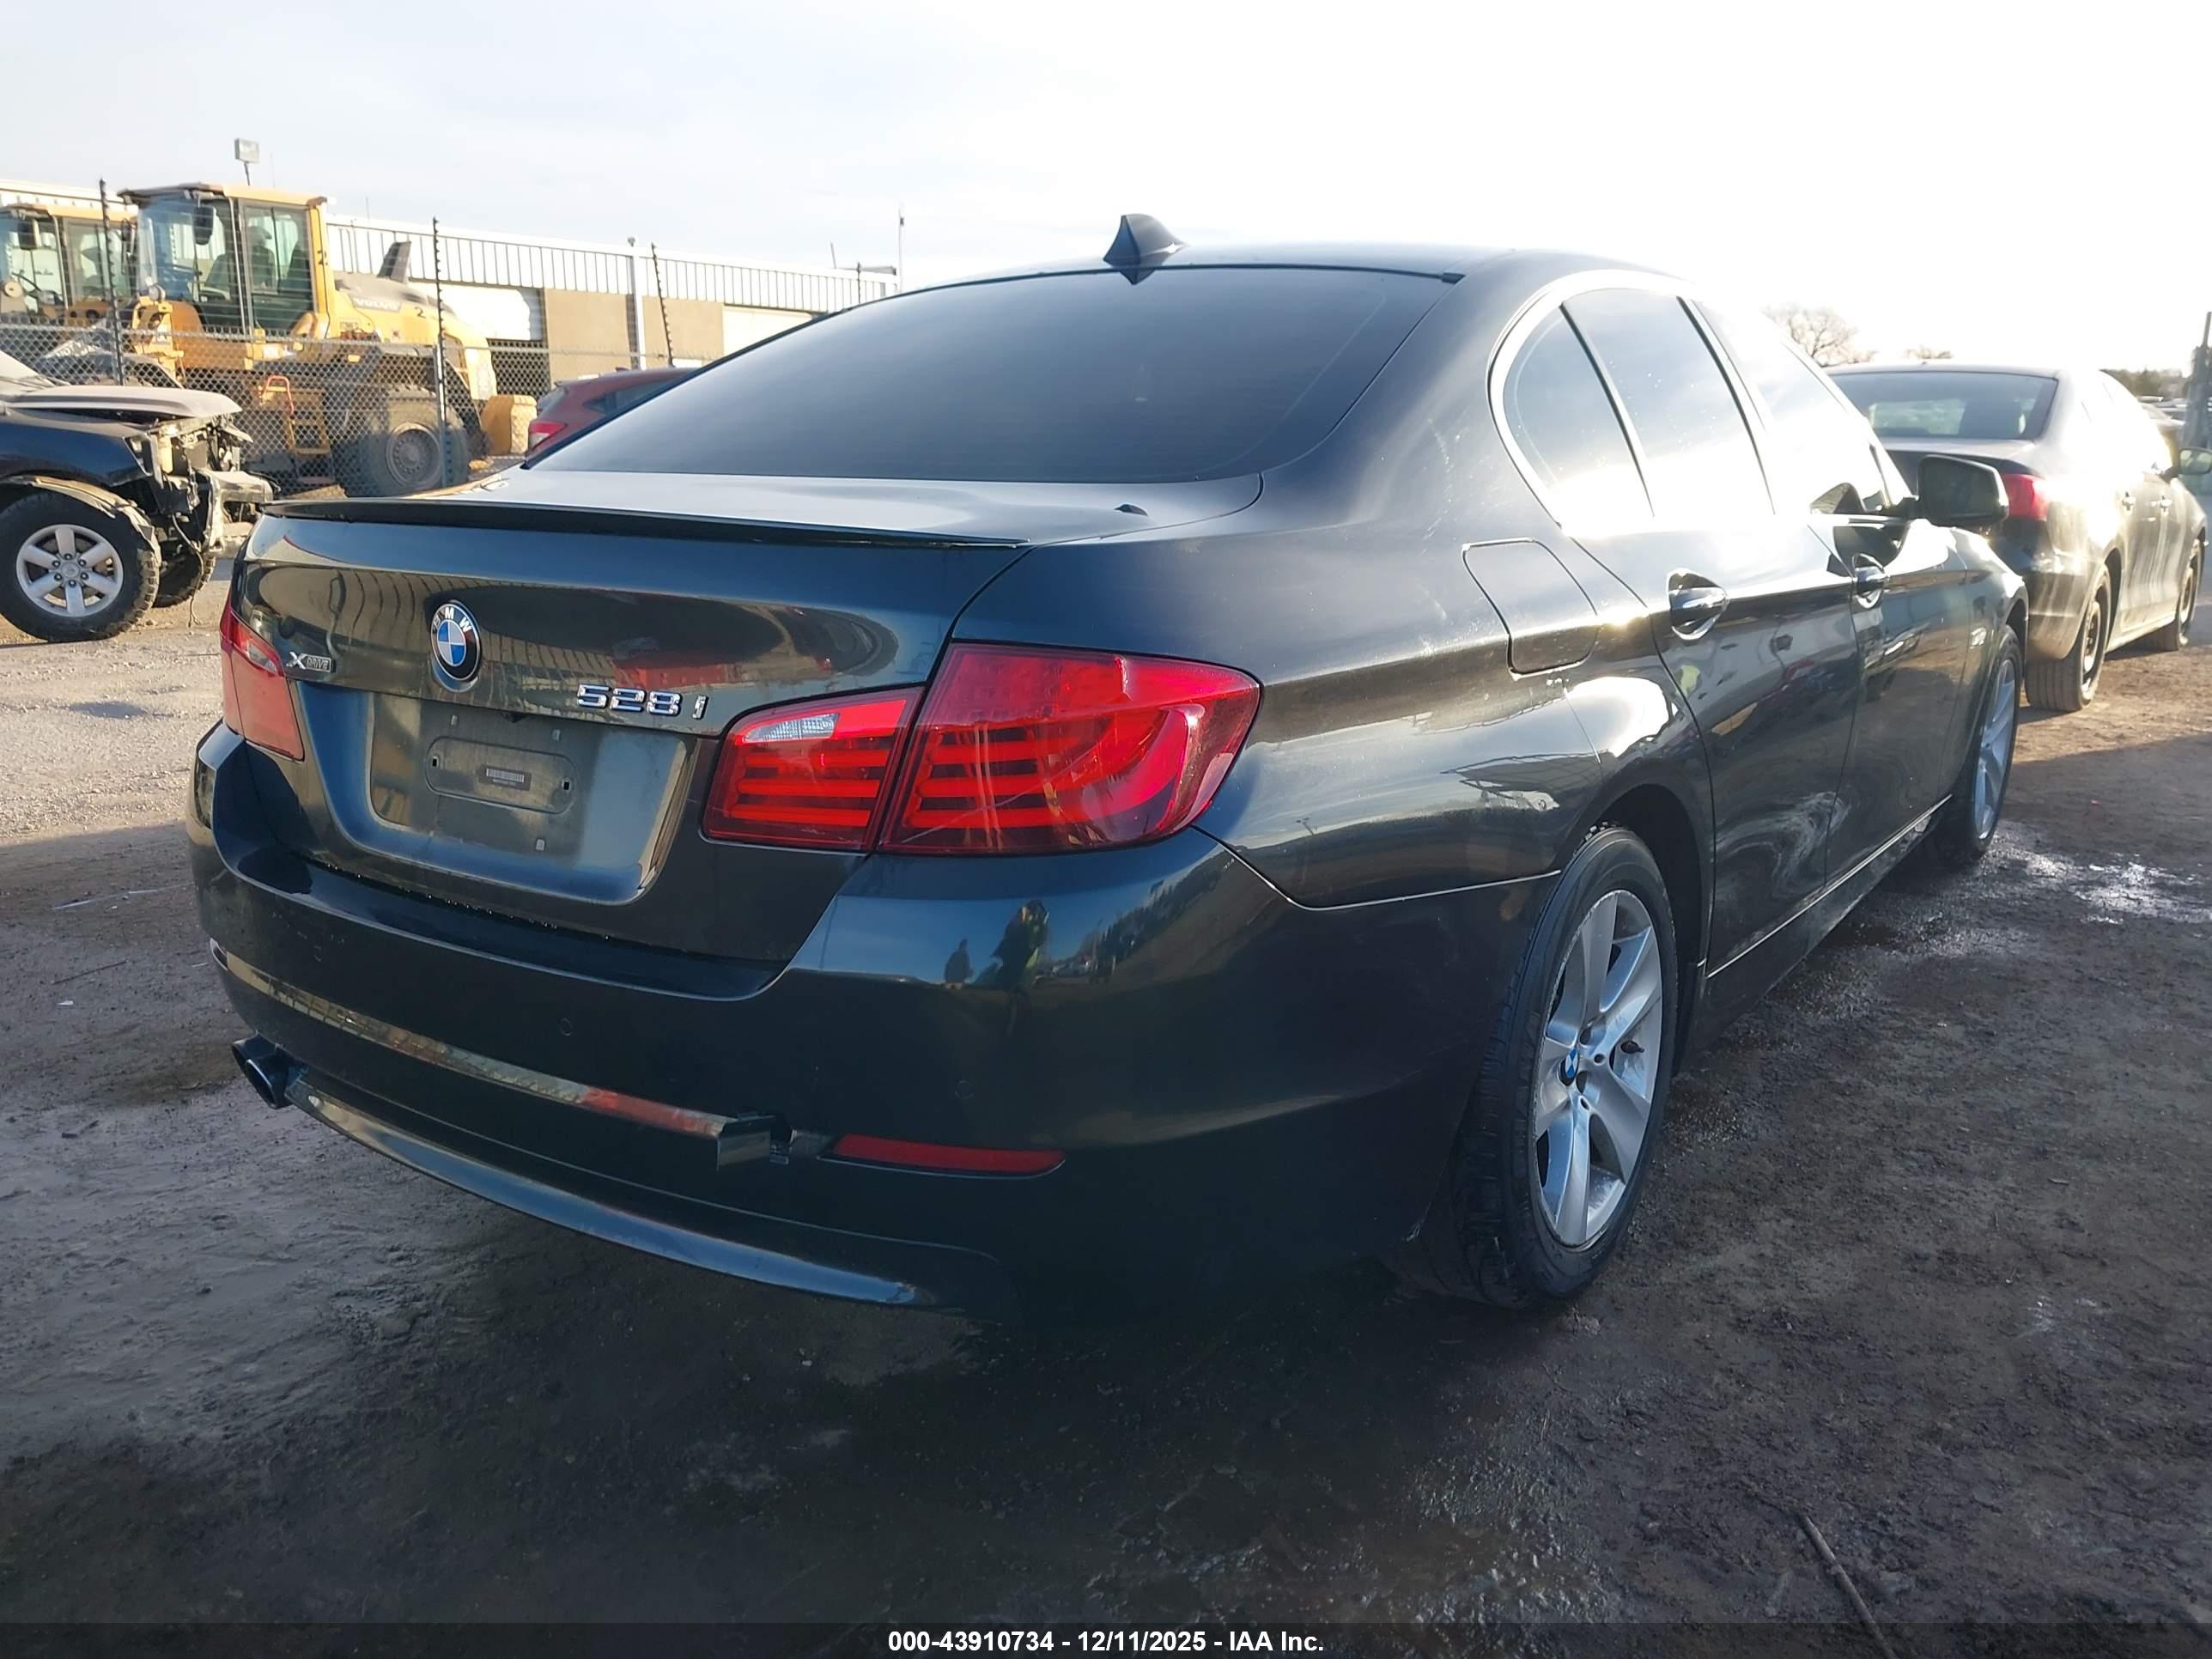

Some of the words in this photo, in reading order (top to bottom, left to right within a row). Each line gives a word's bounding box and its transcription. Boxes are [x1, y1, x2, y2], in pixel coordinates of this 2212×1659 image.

[353, 297, 398, 311] VOLVO
[415, 307, 427, 319] 2
[432, 606, 472, 632] BMW
